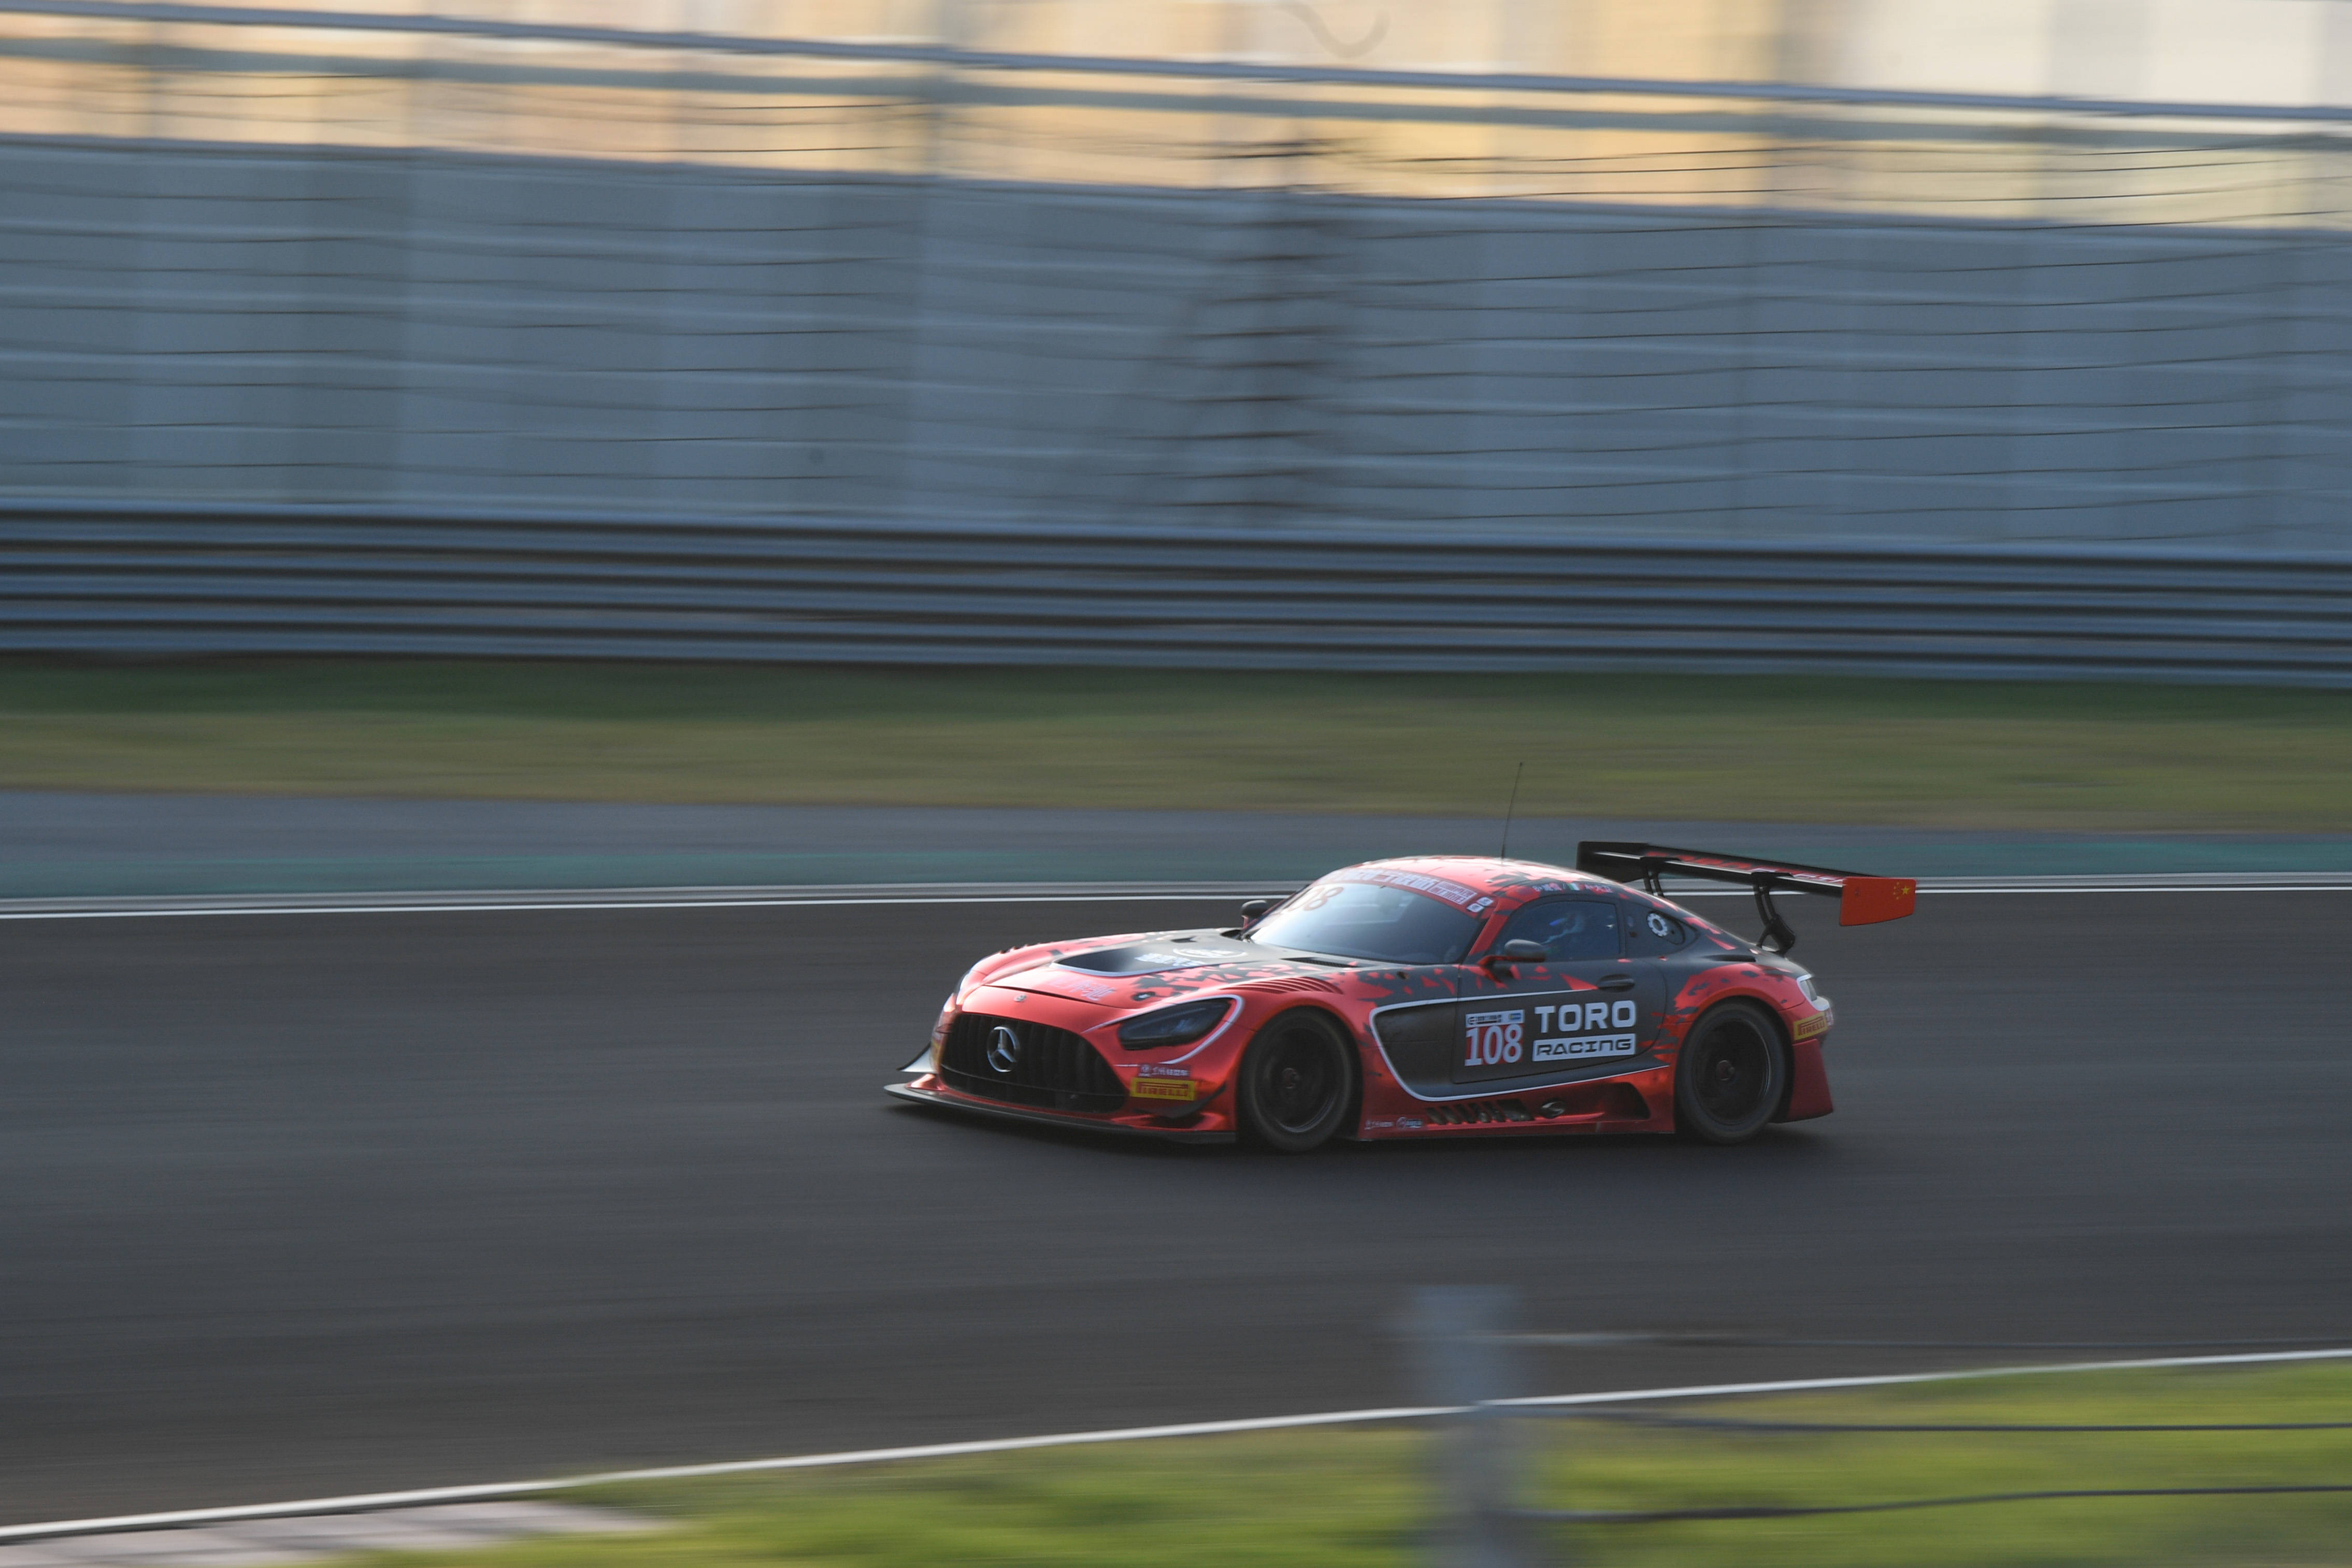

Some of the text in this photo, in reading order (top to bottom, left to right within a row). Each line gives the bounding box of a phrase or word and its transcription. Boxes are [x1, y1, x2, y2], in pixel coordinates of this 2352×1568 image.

[1534, 1000, 1637, 1033] TORO
[1798, 1016, 1825, 1036] PIRELLI
[1464, 1024, 1523, 1066] 108
[1536, 1039, 1632, 1055] RACING
